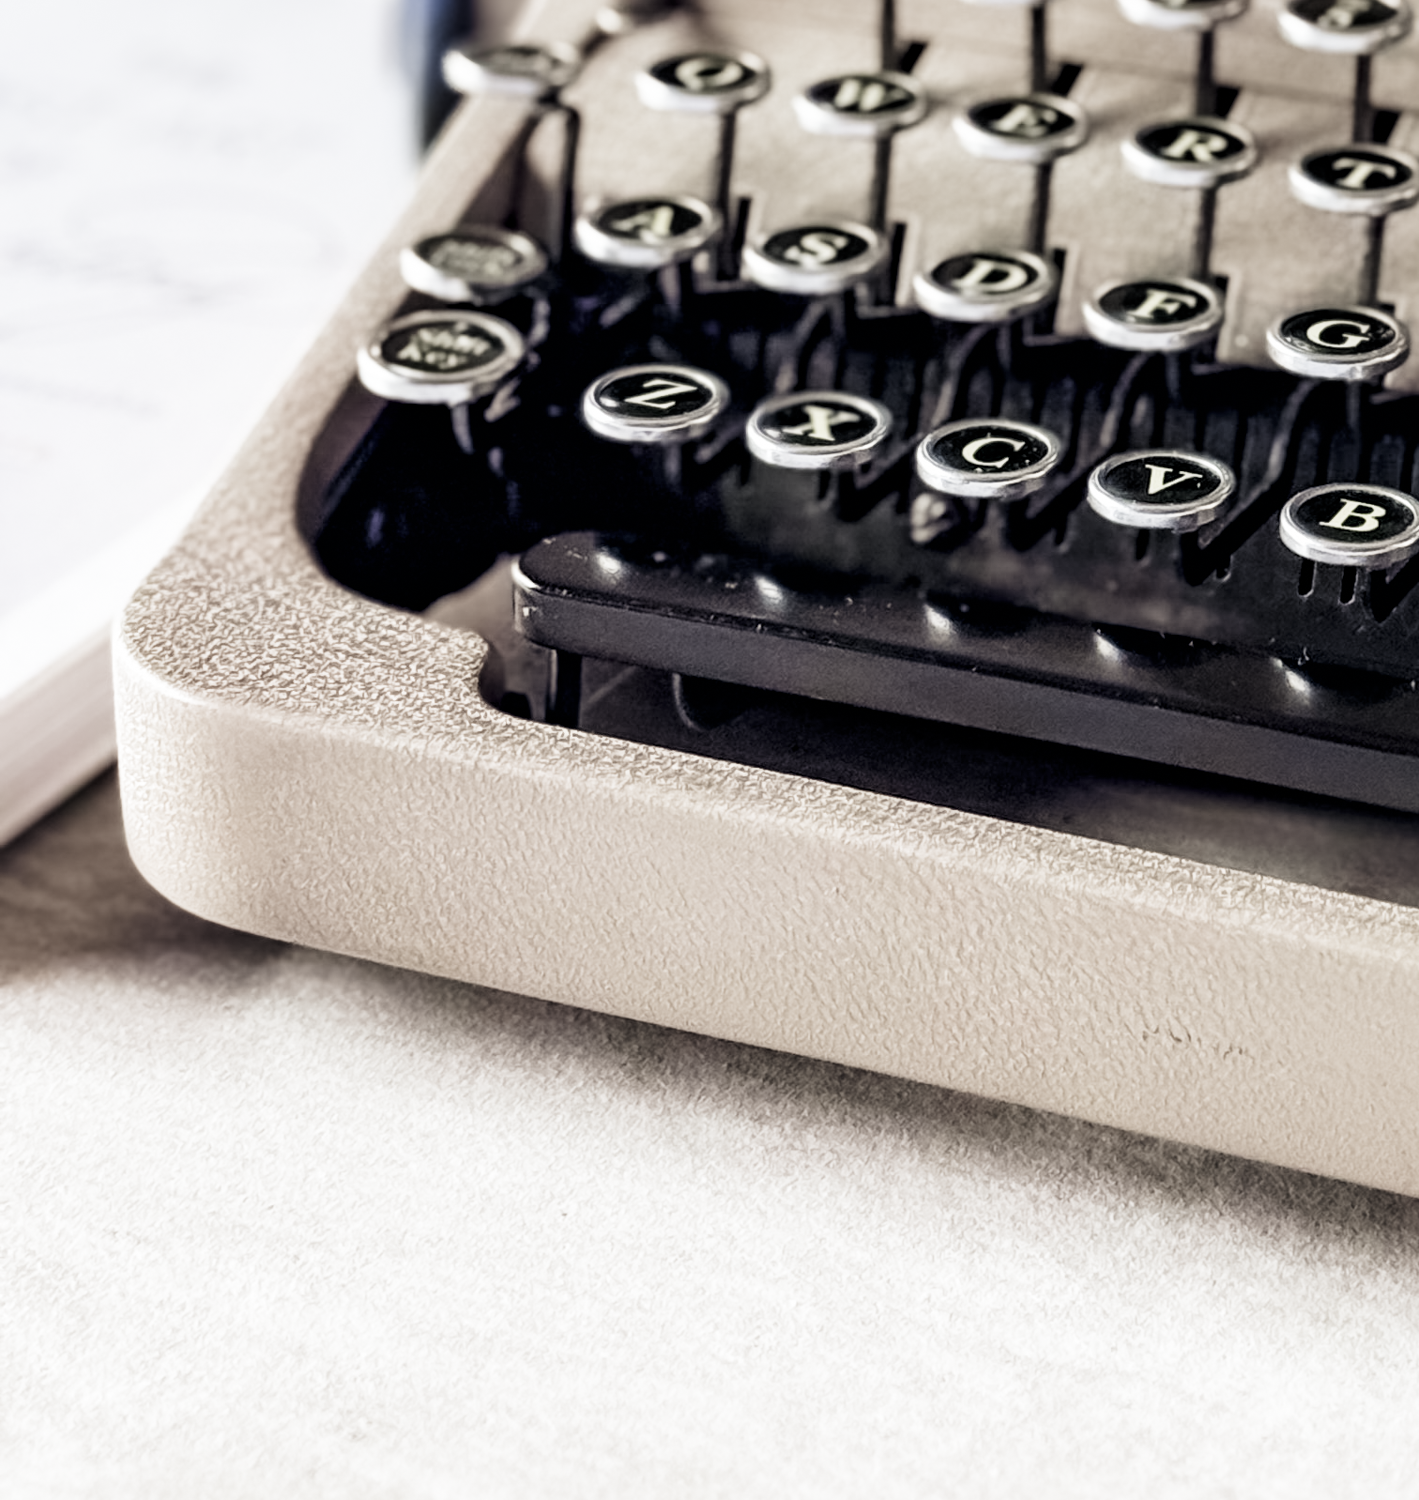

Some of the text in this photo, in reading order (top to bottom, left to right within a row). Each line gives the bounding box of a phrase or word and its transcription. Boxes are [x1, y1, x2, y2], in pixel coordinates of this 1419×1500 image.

[994, 103, 1059, 138] E
[1163, 129, 1228, 163] R
[1332, 156, 1397, 189] T
[610, 205, 675, 246] A
[784, 230, 847, 268] S
[954, 260, 1029, 295] D
[1127, 289, 1197, 319] F
[1305, 319, 1371, 349] G
[624, 377, 698, 410] Z
[781, 405, 862, 442] X
[961, 436, 1026, 469] C
[1144, 464, 1202, 495] V
[1318, 498, 1387, 533] B
